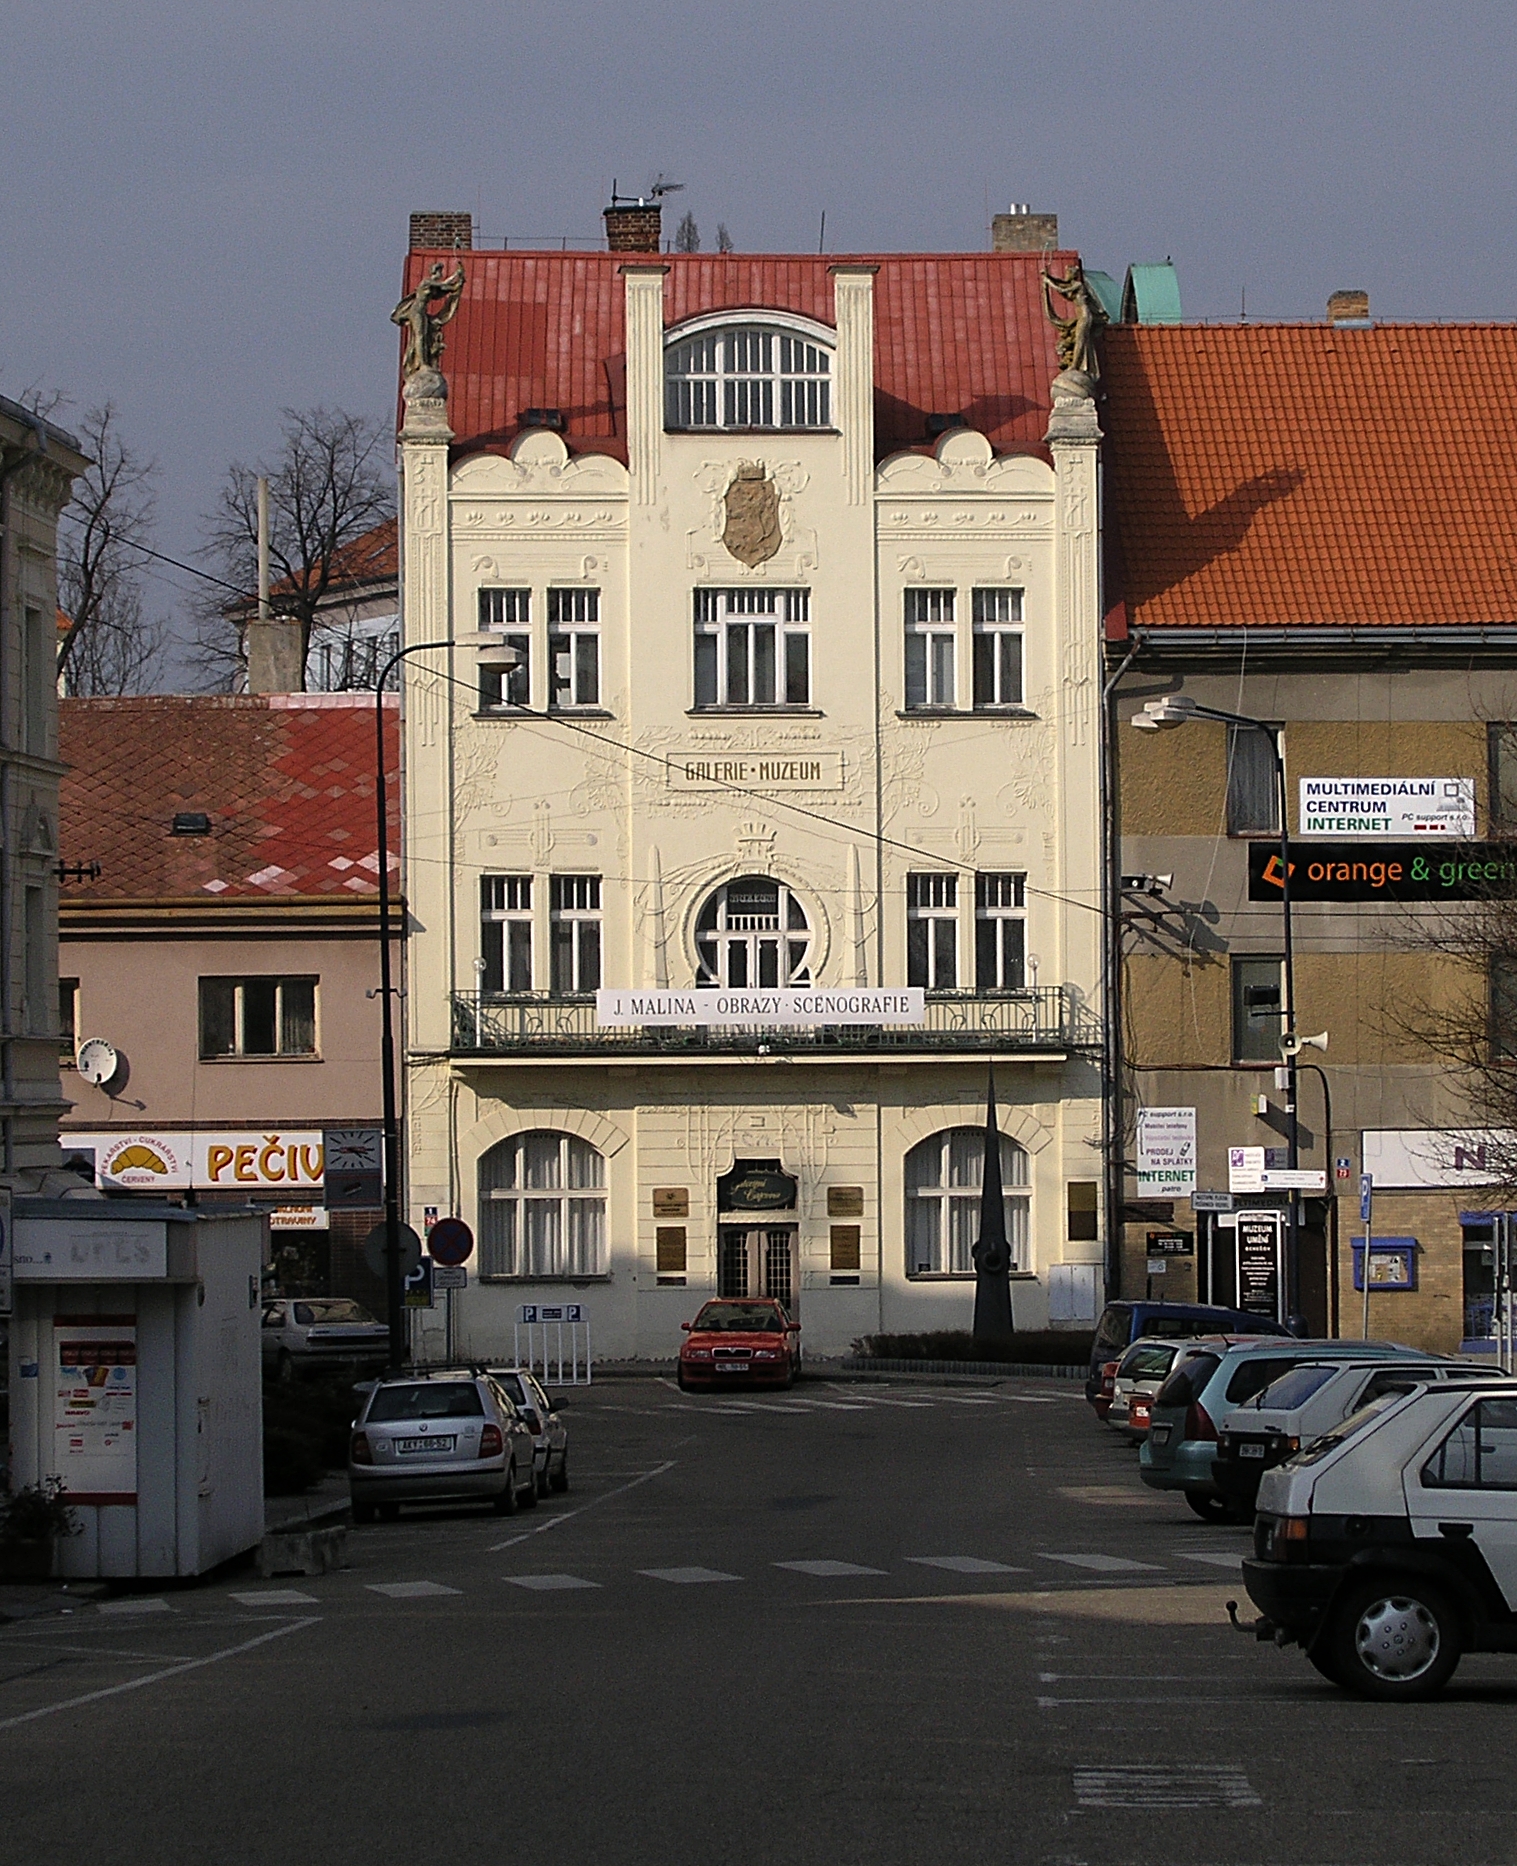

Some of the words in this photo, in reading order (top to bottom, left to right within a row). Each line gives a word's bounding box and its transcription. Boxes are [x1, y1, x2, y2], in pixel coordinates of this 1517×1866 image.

[685, 761, 748, 781] GALERIE
[759, 761, 821, 780] MUZEUM
[1306, 780, 1436, 796] MULTIMEDIÁLNÍ
[1306, 800, 1387, 813] CENTRUM
[1306, 817, 1393, 831] INTERNET
[1401, 813, 1414, 821] PC
[1416, 814, 1448, 823] support
[1307, 862, 1403, 887] orange
[1410, 856, 1430, 881] &
[614, 999, 624, 1016] J.
[630, 998, 697, 1016] MALINA
[716, 997, 783, 1015] OBRAZY
[1146, 1148, 1173, 1156] PRODEJ
[1151, 1158, 1161, 1166] NA
[1163, 1156, 1194, 1166] SPLÁTKY
[1138, 1169, 1195, 1183] INTERNET
